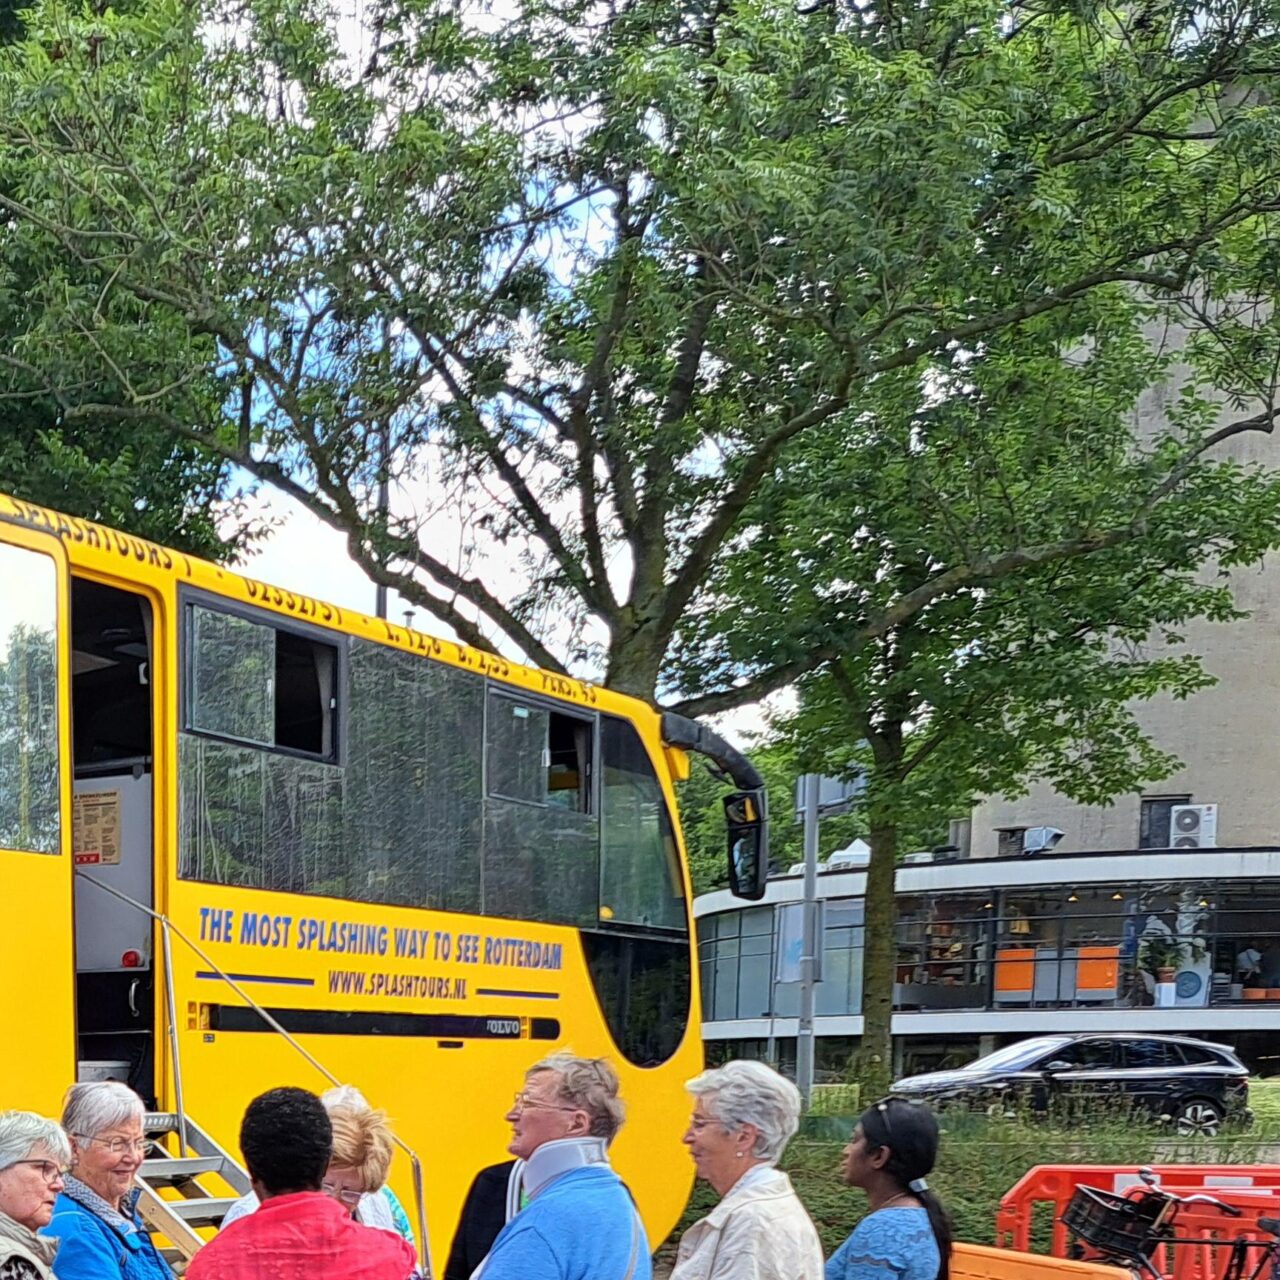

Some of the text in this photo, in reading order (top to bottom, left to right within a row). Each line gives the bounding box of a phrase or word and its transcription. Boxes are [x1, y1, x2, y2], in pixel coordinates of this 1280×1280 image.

[199, 907, 563, 970] THE MOST SPLASHING WAY TO SEE ROTTERDAM
[328, 970, 467, 1000] WWW.SPLASHTOURS.NL
